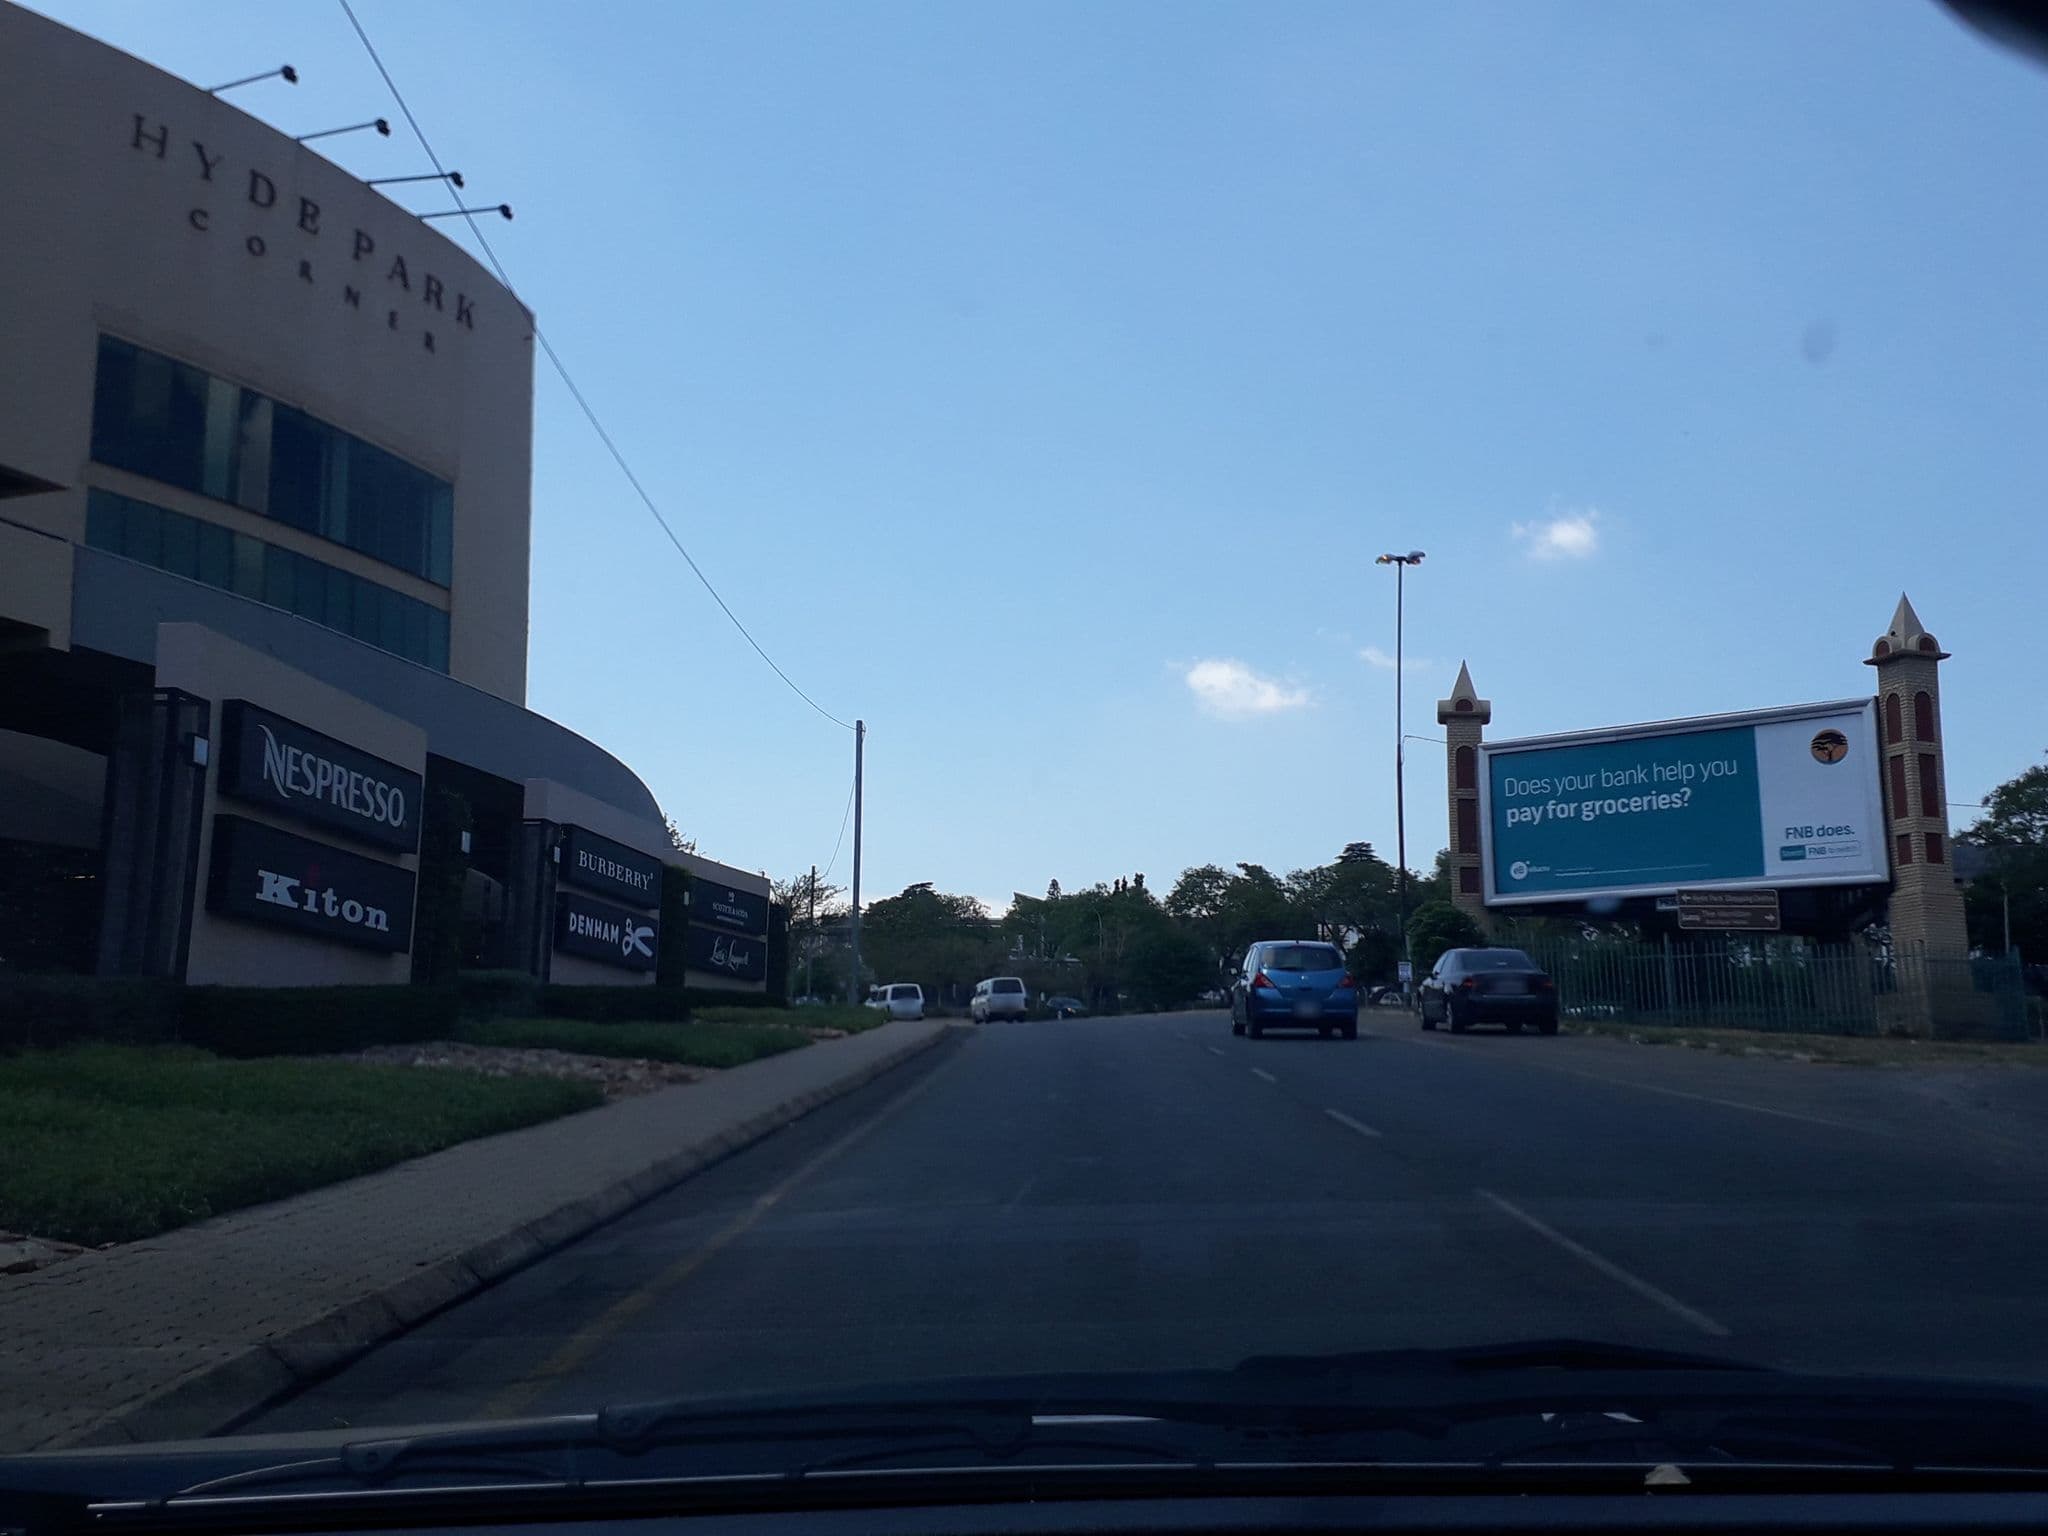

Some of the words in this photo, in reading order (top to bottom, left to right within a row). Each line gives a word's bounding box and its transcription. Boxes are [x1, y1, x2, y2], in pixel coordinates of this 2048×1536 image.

[132, 113, 320, 234] HYDE
[351, 228, 477, 331] PARK
[189, 207, 437, 355] CORNER
[257, 723, 406, 828] NESPRESSO
[1504, 777, 1551, 797] Does
[1554, 773, 1596, 796] your
[1601, 765, 1649, 788] bank
[1653, 760, 1695, 784] help
[1699, 759, 1737, 783] you
[1506, 804, 1549, 828] pay
[1549, 800, 1578, 819] for
[1581, 787, 1692, 821] groceries?
[1785, 825, 1813, 839] FNB
[1816, 824, 1855, 837] does.
[1808, 846, 1827, 856] FNB
[578, 850, 654, 891] BURBERRY
[255, 868, 390, 931] Kiton
[568, 911, 620, 945] DENHAM
